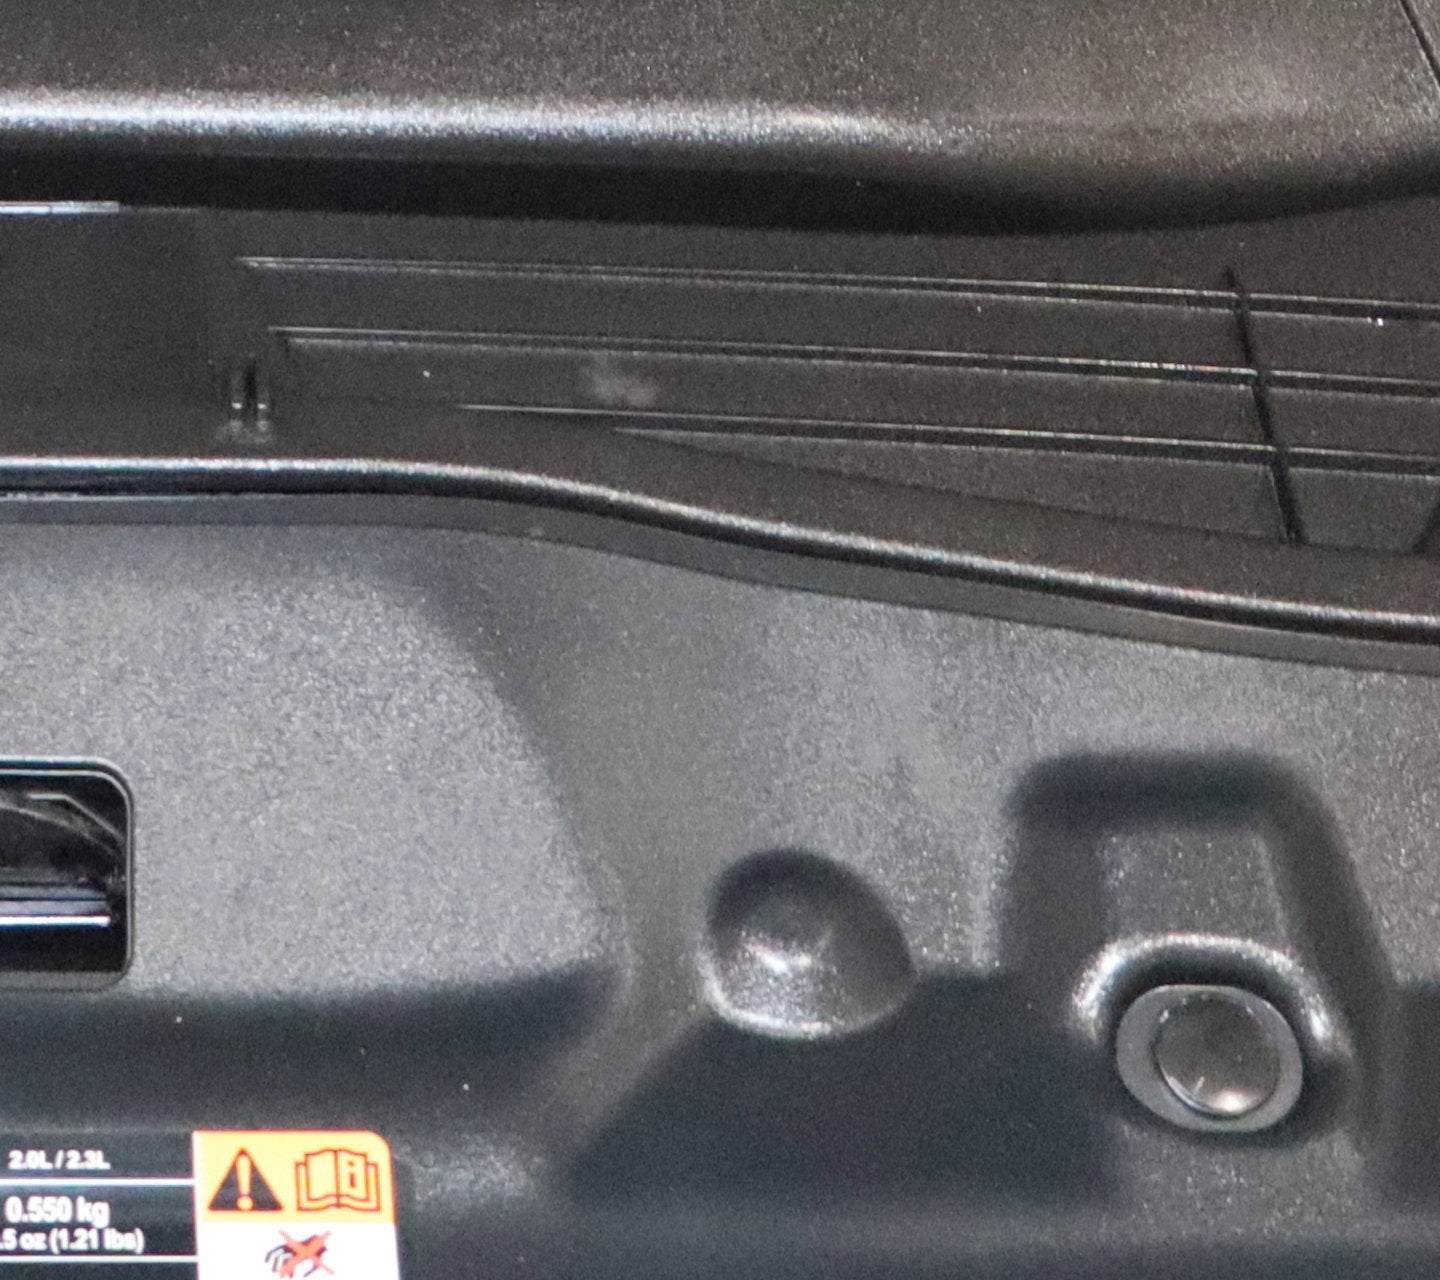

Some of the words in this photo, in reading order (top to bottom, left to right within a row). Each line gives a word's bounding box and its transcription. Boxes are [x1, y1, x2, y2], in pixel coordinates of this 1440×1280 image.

[8, 1149, 53, 1170] 2.0L
[66, 1149, 111, 1170] 2.3L
[5, 1196, 72, 1223] 0.550
[76, 1196, 110, 1228] kg
[19, 1232, 47, 1251] oz
[49, 1228, 99, 1255] (1.21
[103, 1228, 146, 1255] lbs)
